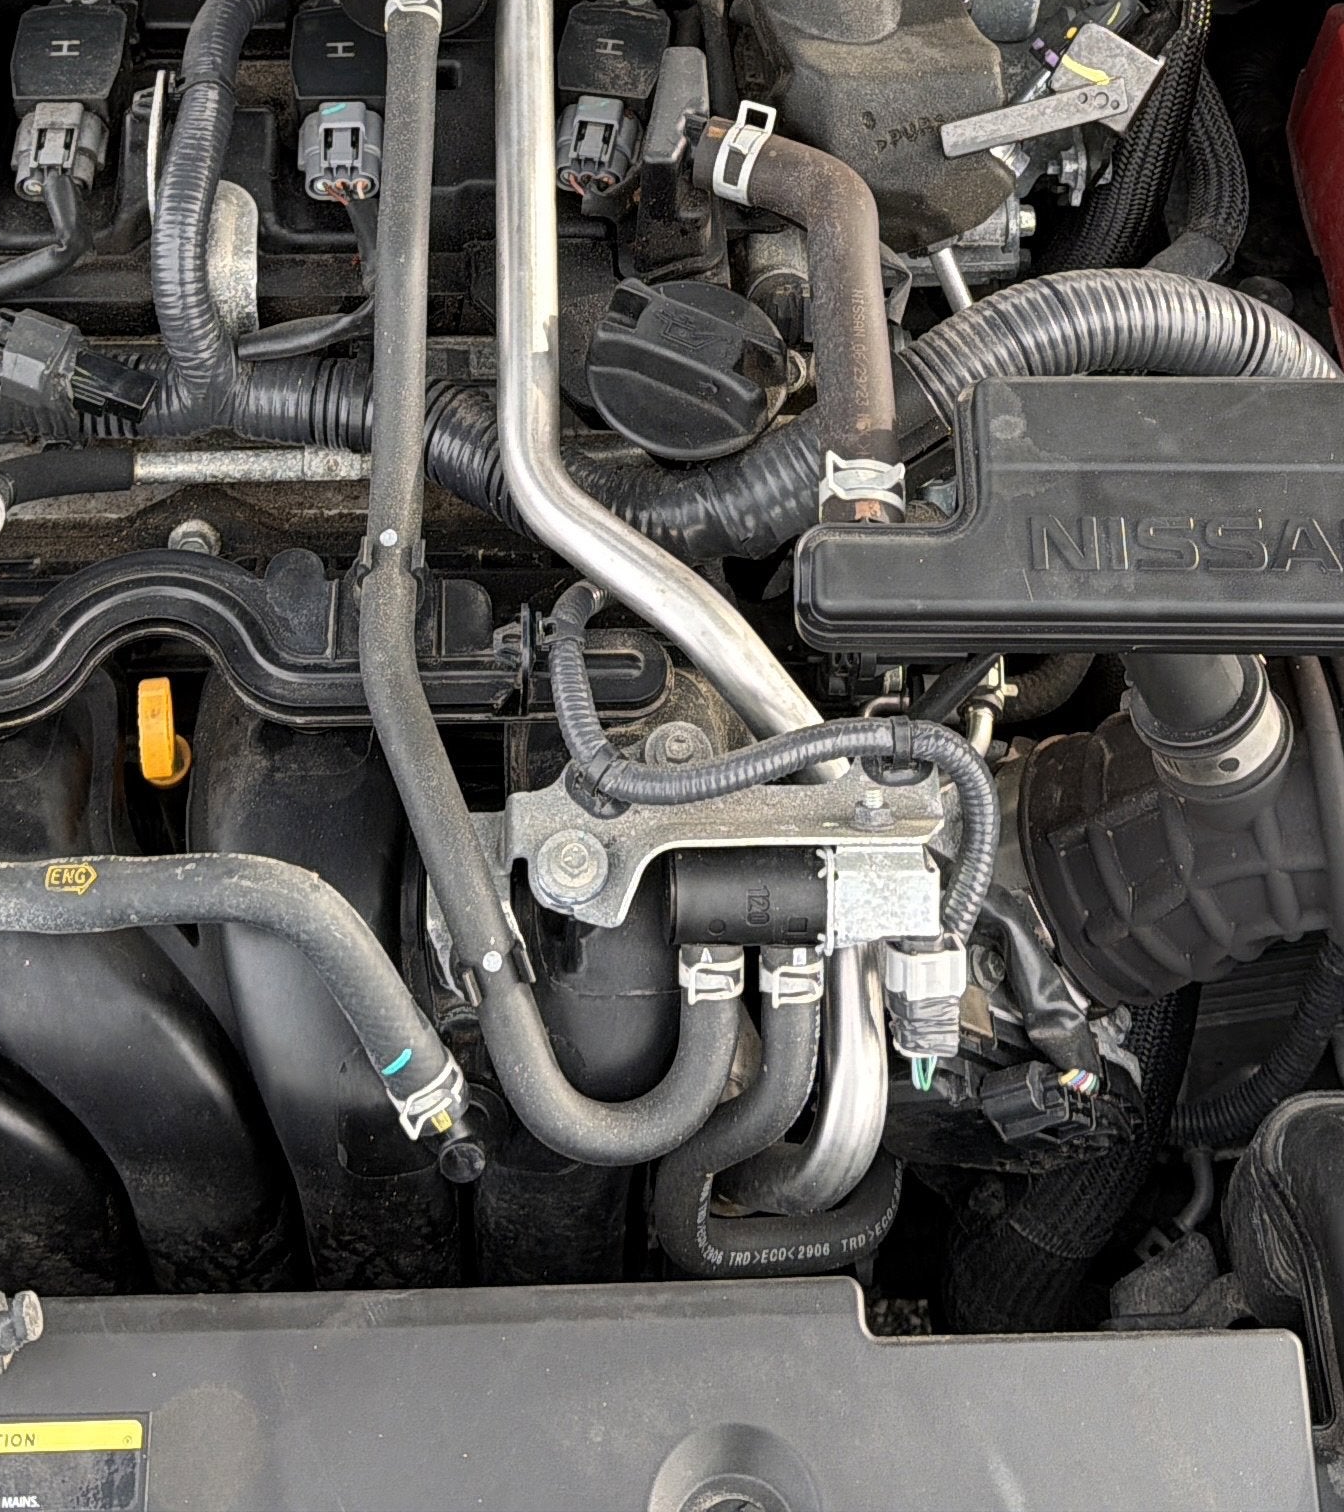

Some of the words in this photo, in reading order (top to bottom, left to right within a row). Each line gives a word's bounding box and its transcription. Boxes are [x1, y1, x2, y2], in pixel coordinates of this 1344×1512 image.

[852, 289, 866, 337] NISSAN
[50, 867, 87, 885] ENG
[746, 885, 771, 927] 120
[1, 1495, 40, 1509] MAINS.
